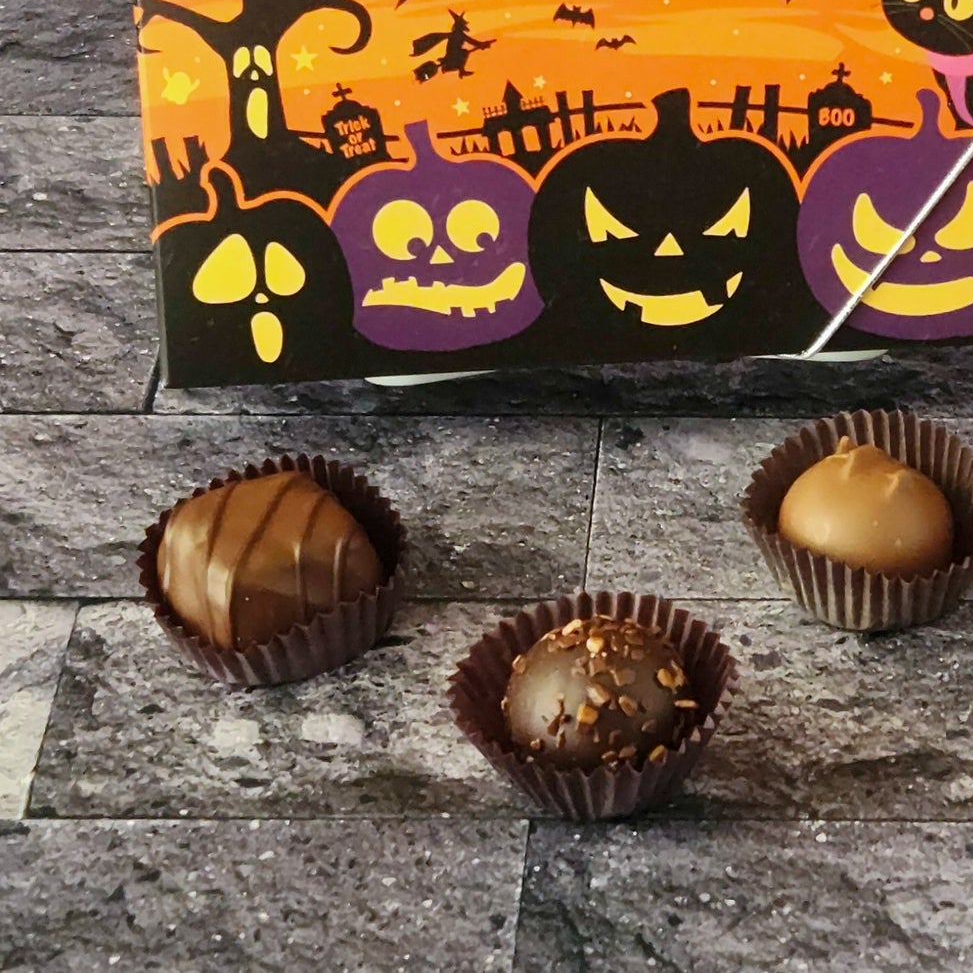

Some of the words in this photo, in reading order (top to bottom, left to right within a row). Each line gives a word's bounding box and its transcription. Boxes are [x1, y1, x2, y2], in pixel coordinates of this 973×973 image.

[334, 115, 370, 136] Trick
[818, 107, 855, 127] BOO
[340, 137, 376, 158] Treat
